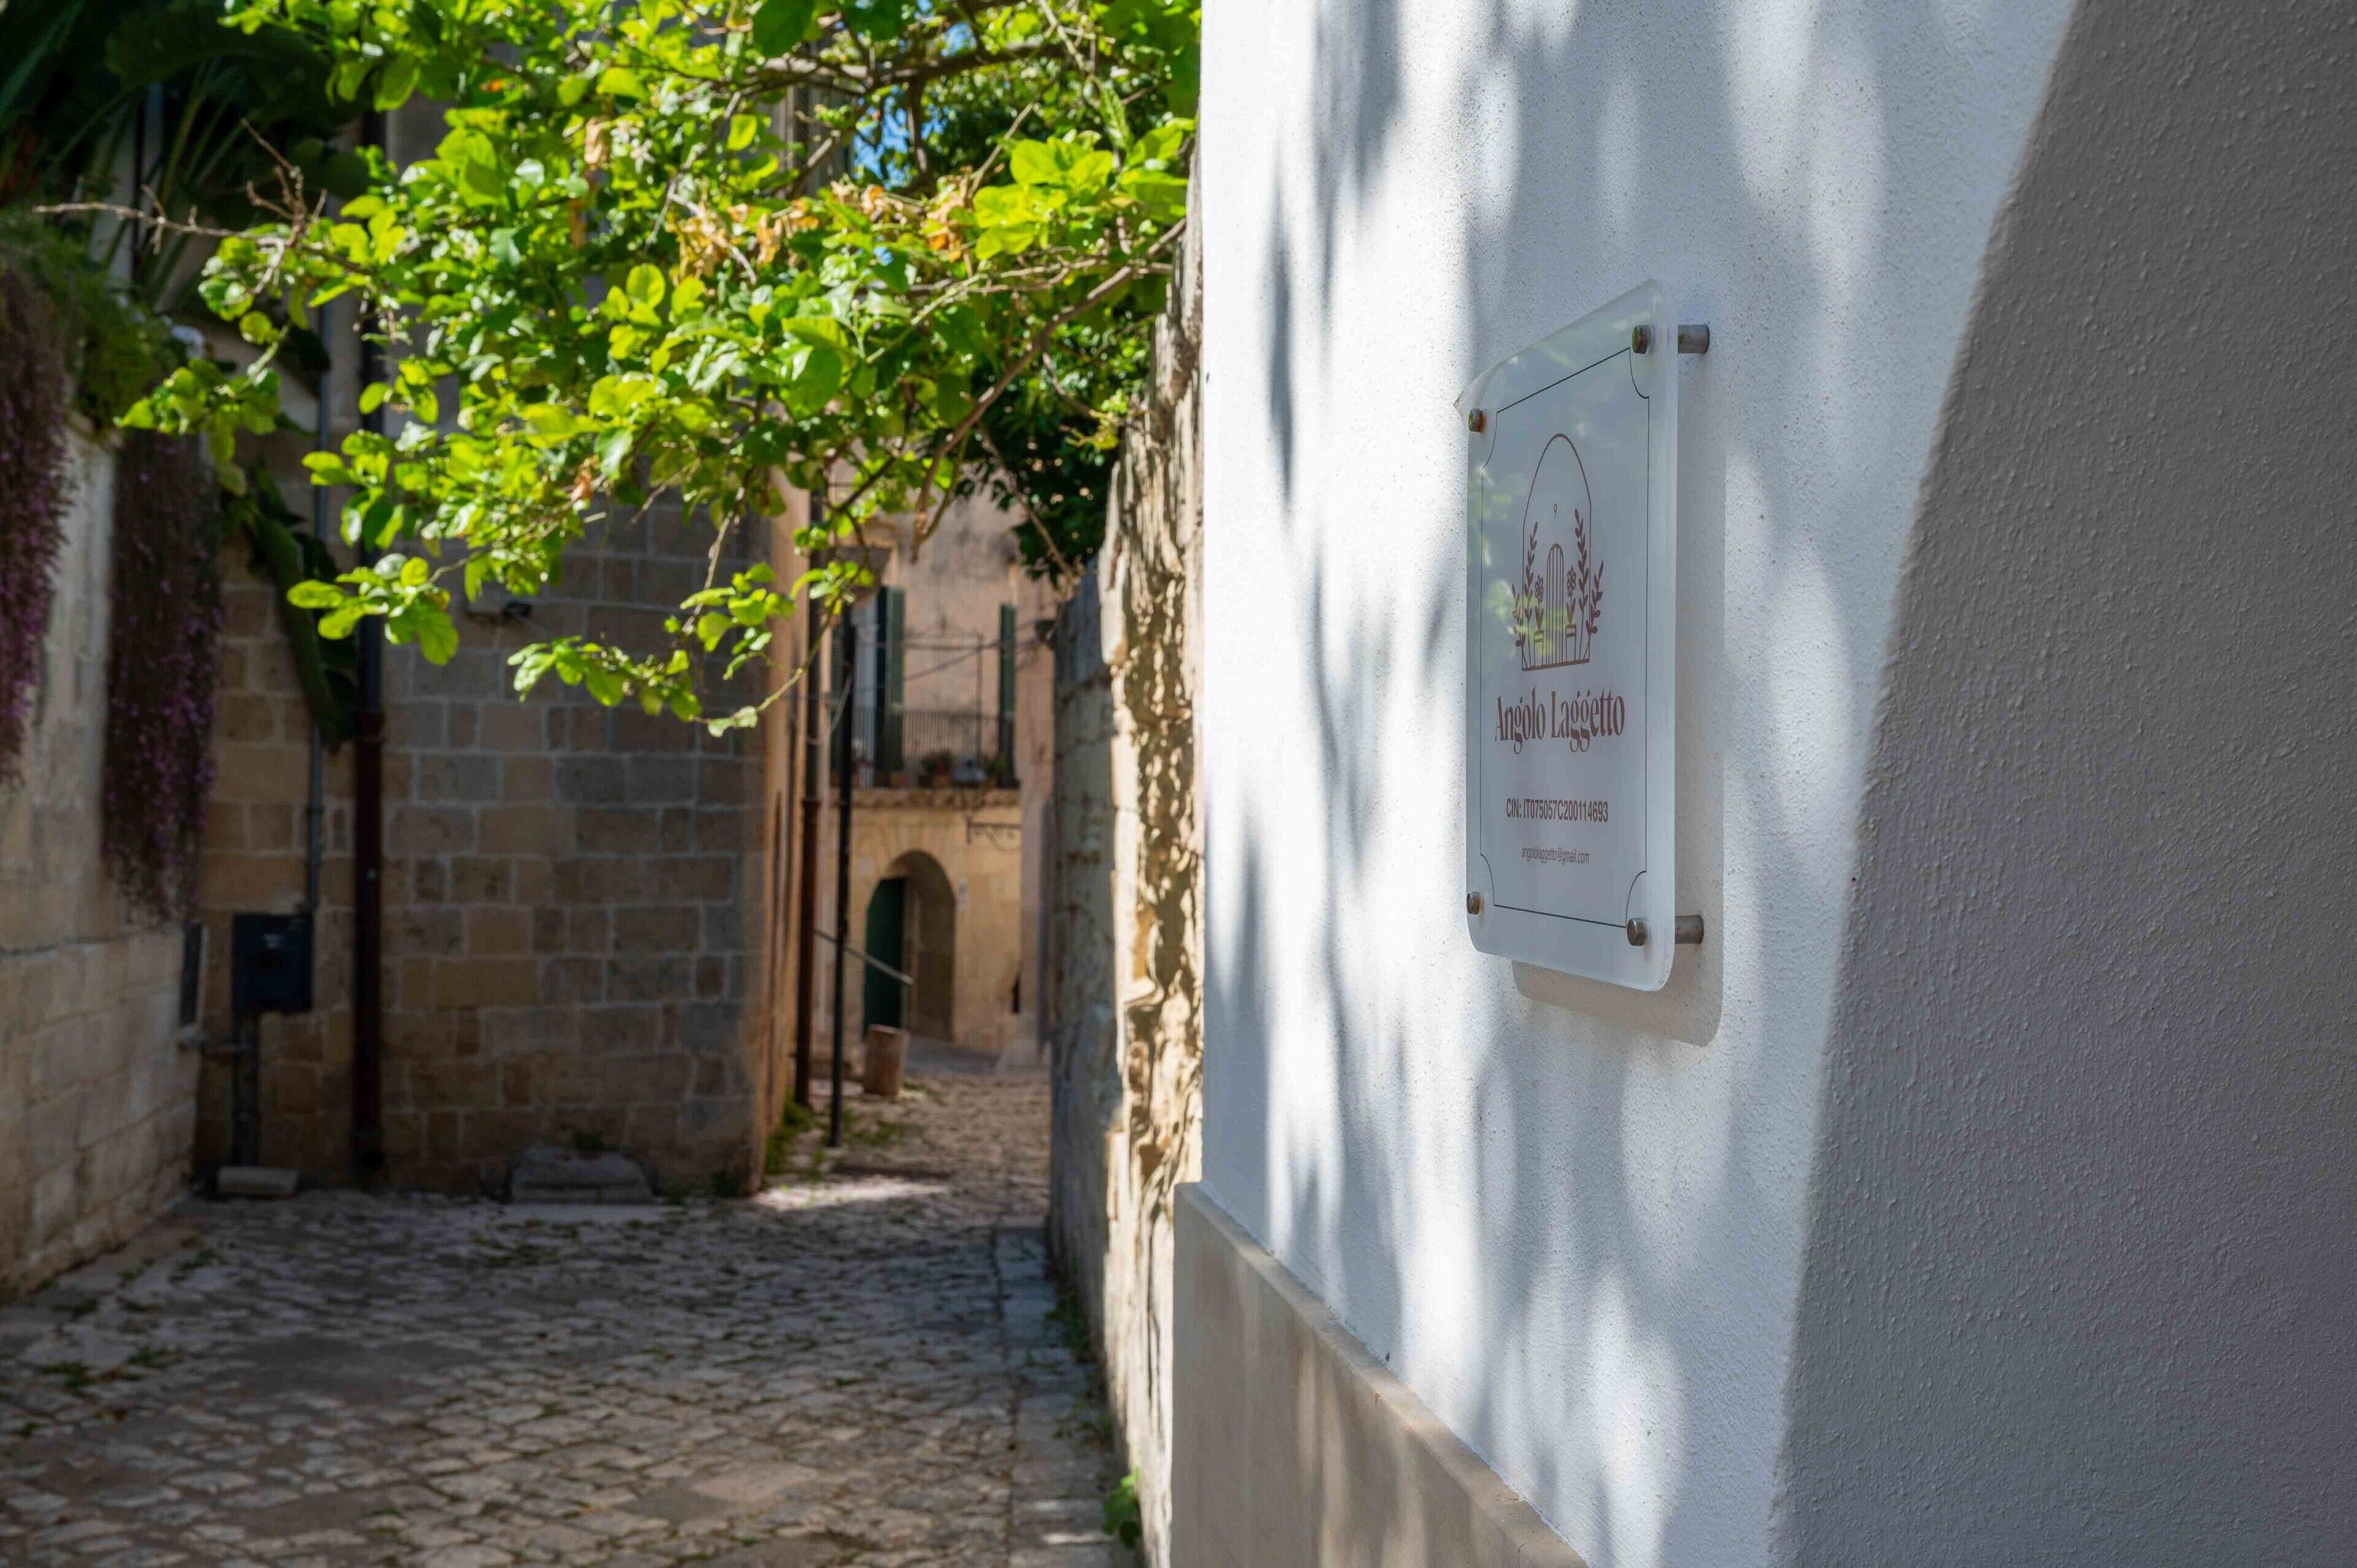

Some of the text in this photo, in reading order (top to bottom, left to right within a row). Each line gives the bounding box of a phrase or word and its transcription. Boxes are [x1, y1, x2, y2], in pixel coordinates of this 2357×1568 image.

[1554, 503, 1557, 518] 9
[1495, 686, 1625, 754] Angolo Laggetto
[1506, 797, 1608, 822] CIN: IT075057C200114693
[1521, 846, 1590, 865] angololaggetto@gmail.com
